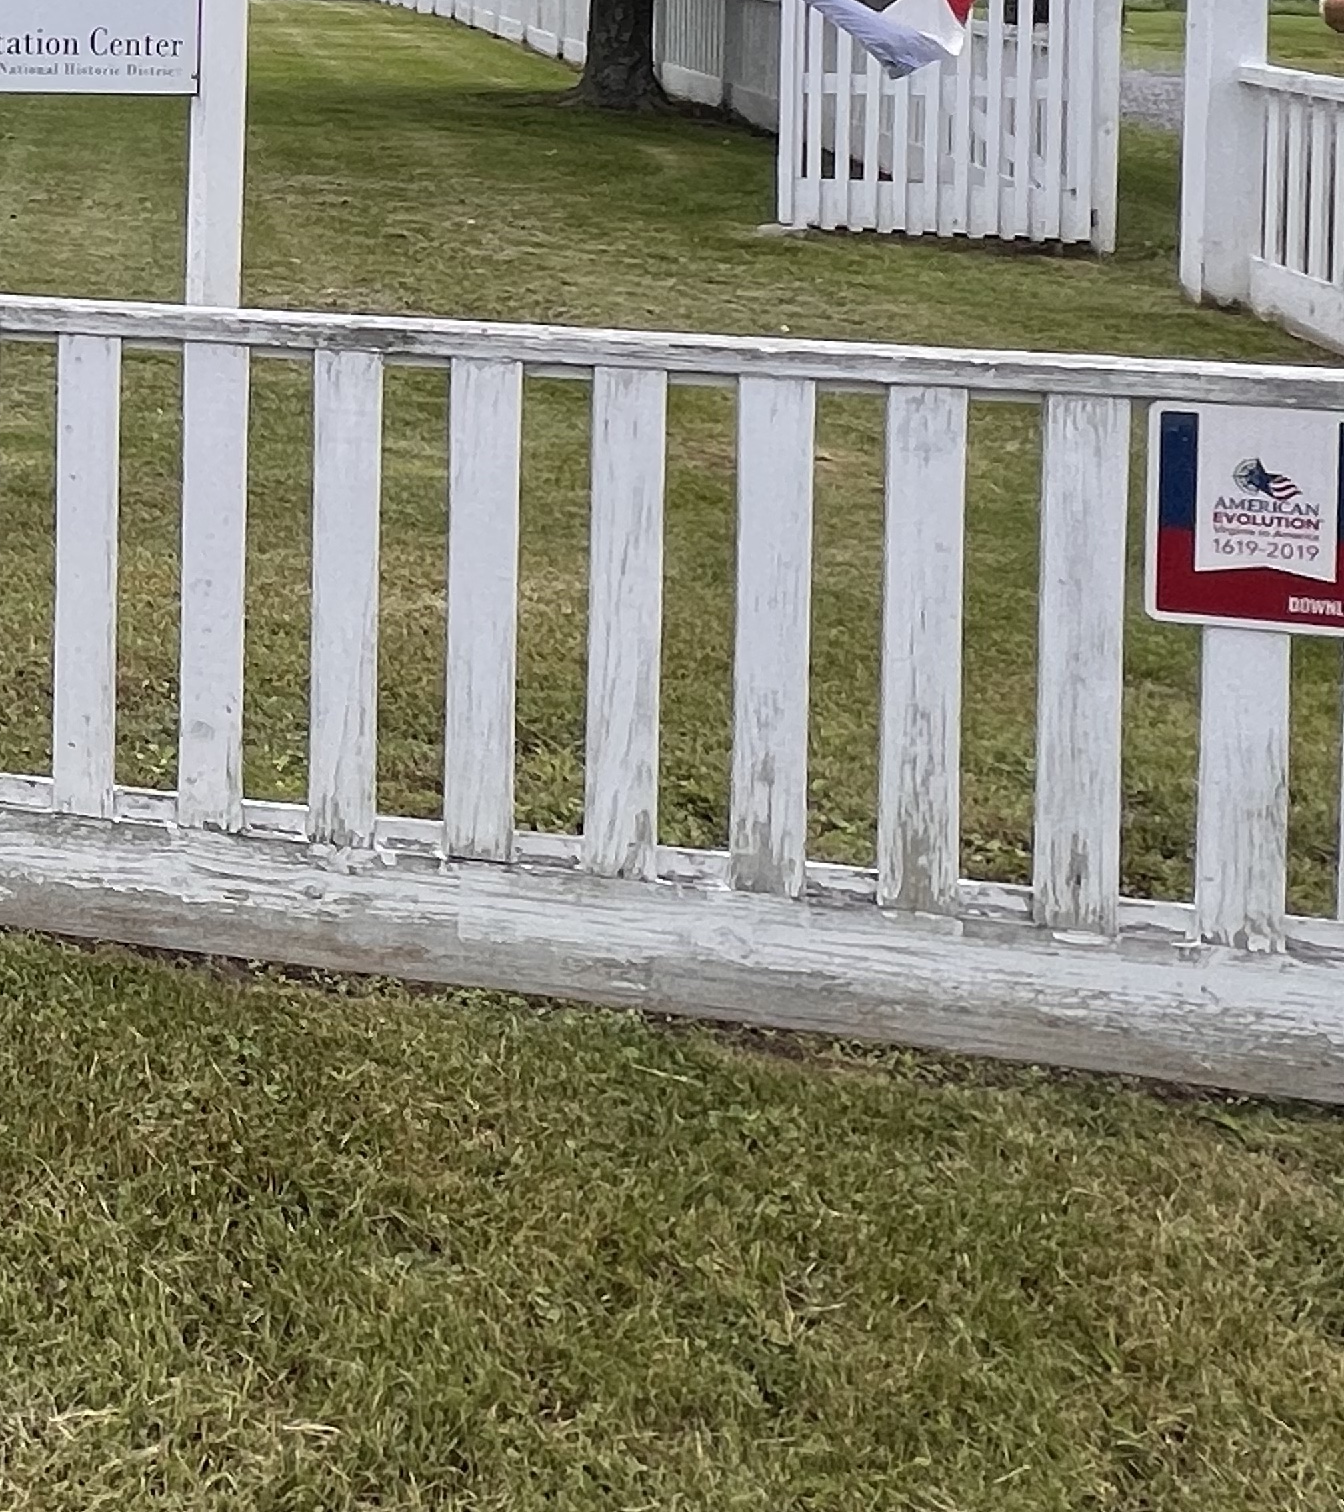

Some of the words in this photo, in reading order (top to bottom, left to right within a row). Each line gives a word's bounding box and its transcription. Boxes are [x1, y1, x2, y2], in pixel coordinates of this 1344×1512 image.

[90, 26, 184, 58] Center
[64, 63, 121, 76] Historic
[126, 63, 183, 77] District
[1214, 496, 1320, 517] AMERICAN
[1213, 511, 1320, 530] EVOLUTION
[1213, 538, 1320, 561] 1619-2019
